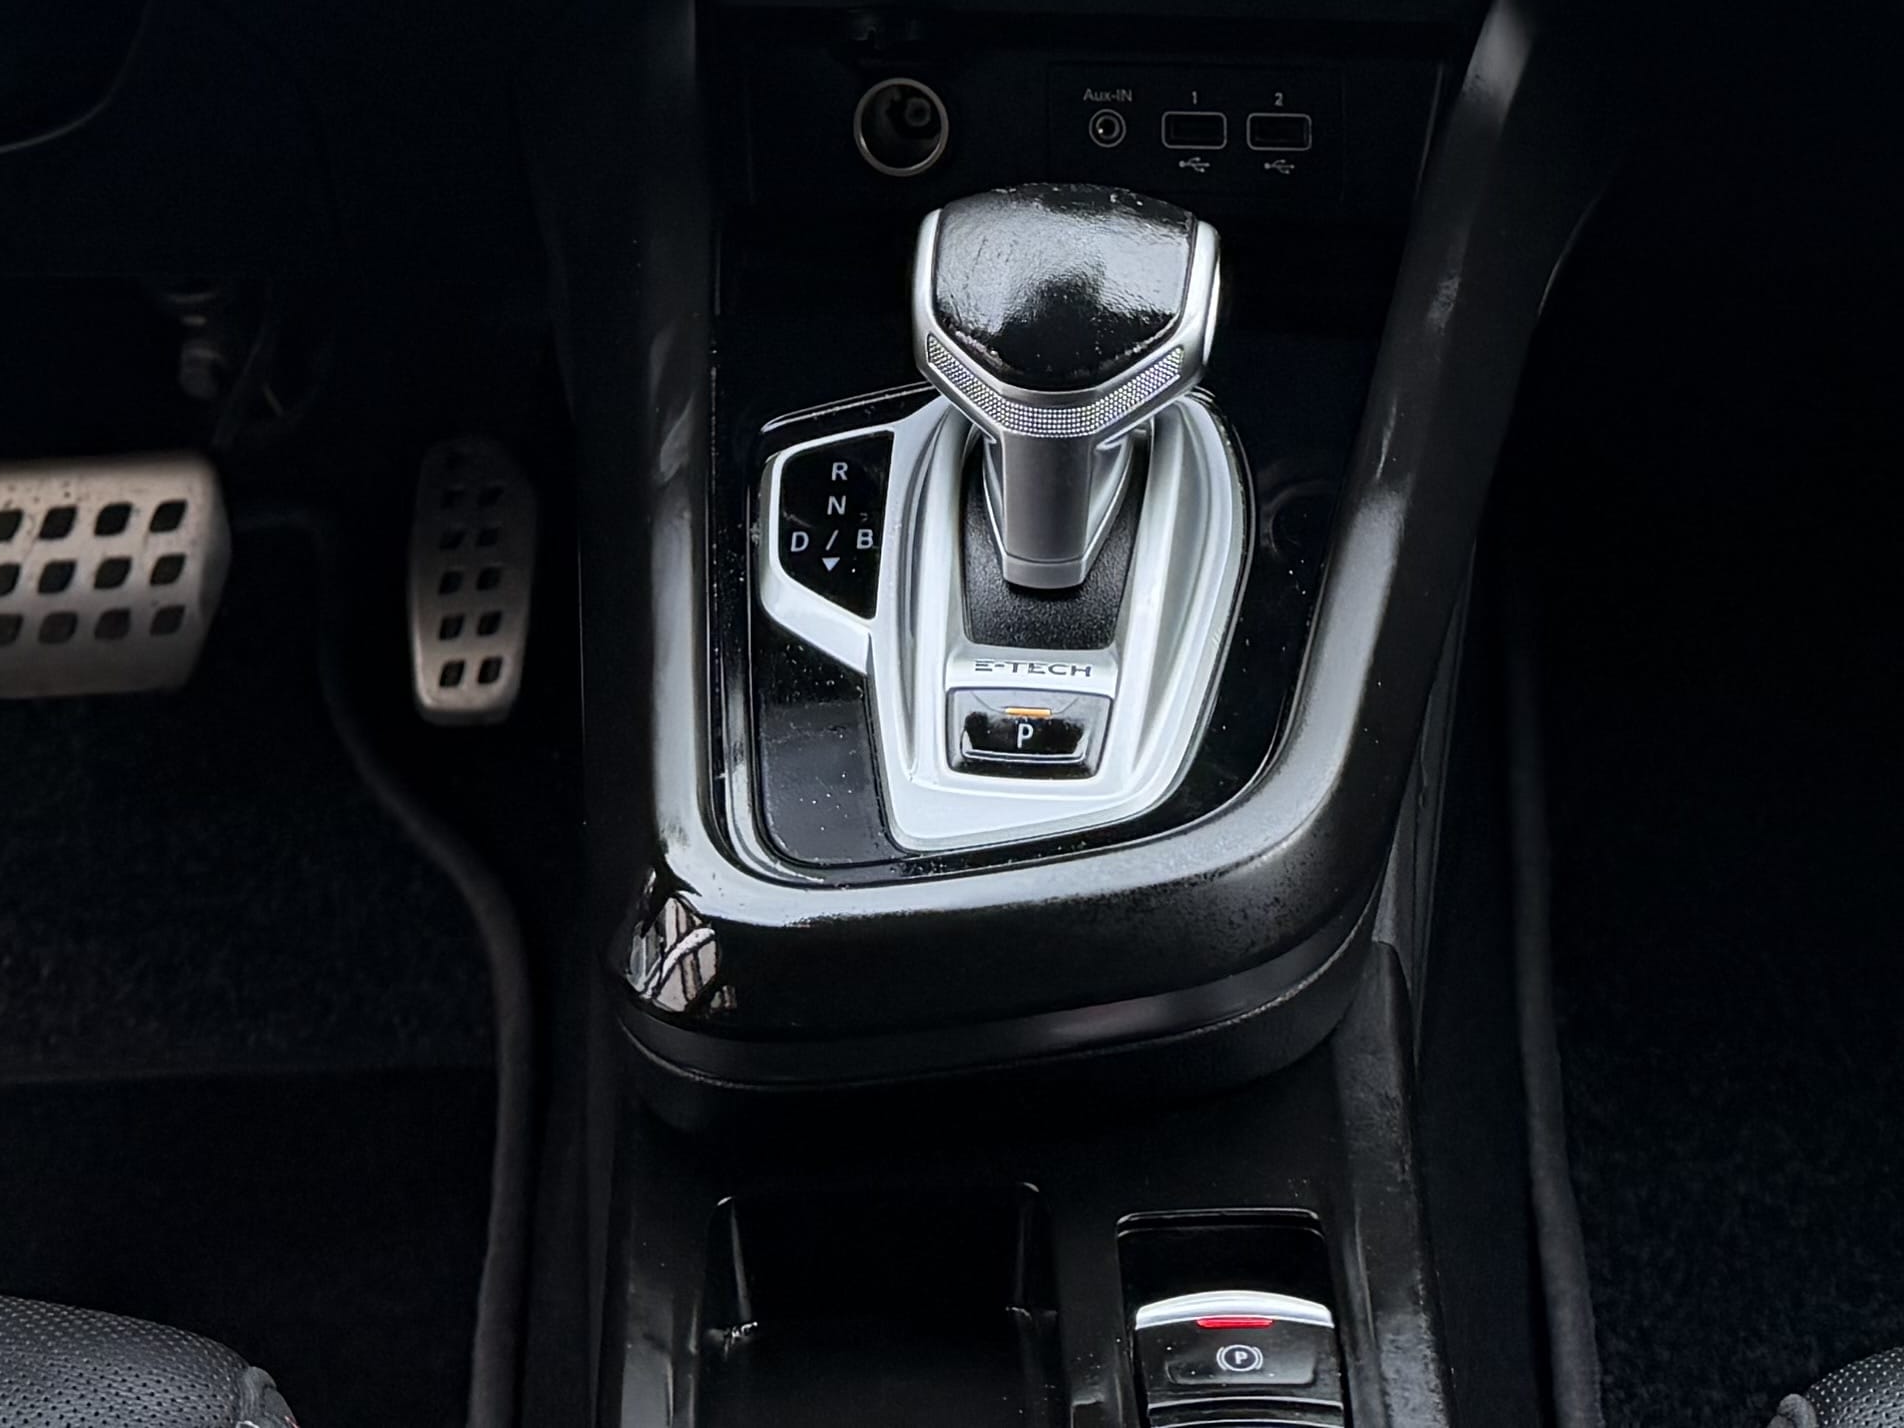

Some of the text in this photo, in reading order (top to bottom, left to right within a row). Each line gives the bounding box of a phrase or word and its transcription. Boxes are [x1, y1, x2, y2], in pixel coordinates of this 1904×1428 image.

[1082, 86, 1134, 104] Aux-IN
[1273, 91, 1285, 107] 2
[831, 461, 849, 481] R
[826, 495, 846, 516] N
[973, 659, 1094, 678] E-TECH
[1016, 723, 1034, 749] P
